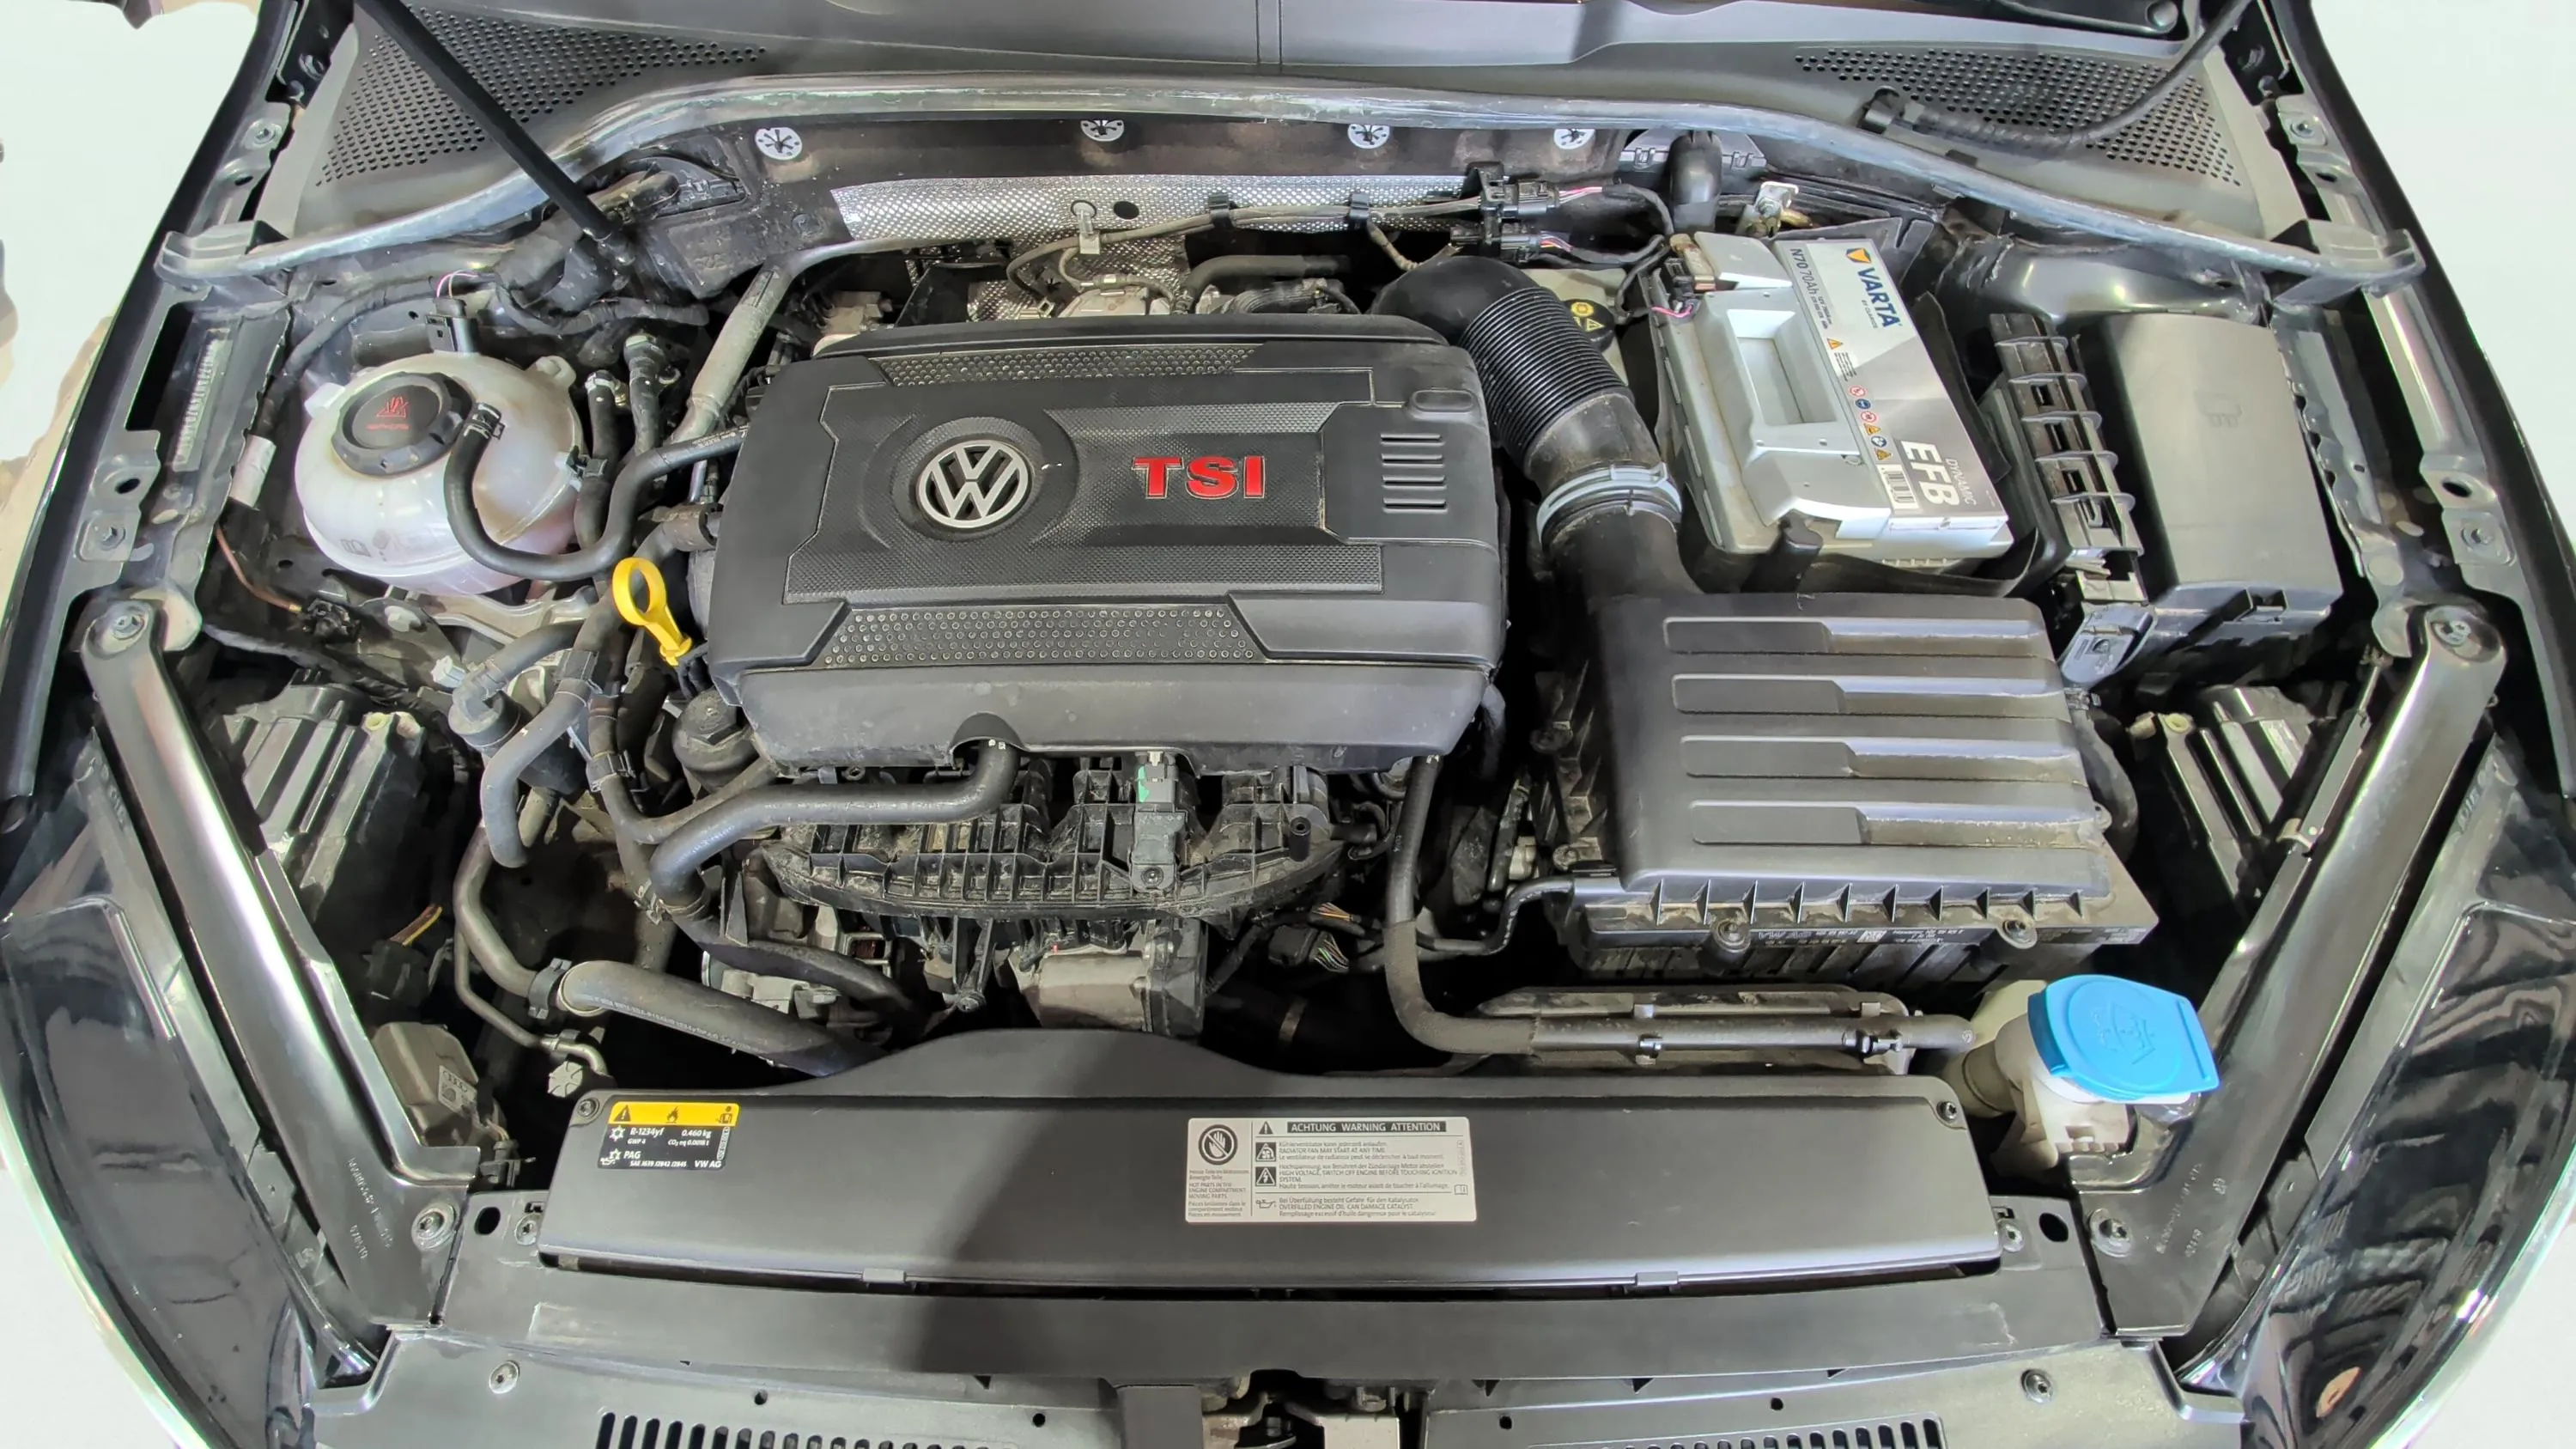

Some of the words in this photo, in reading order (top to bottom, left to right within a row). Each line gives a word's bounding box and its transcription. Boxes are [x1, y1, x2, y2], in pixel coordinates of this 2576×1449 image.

[1790, 248, 1808, 269] N70
[1800, 271, 1820, 295] 70Ah
[1857, 267, 1901, 327] VARTA
[1132, 455, 1267, 499] TSI
[1901, 441, 1960, 505] EFB
[1945, 458, 1977, 506] DYNAMIC
[629, 1127, 665, 1138] R-1234yf
[702, 1129, 713, 1139] kg
[1291, 1123, 1337, 1132] ACHTUNG
[1341, 1123, 1386, 1131] WARNING
[1391, 1123, 1441, 1131] ATTENTION
[623, 1151, 641, 1160] PAG
